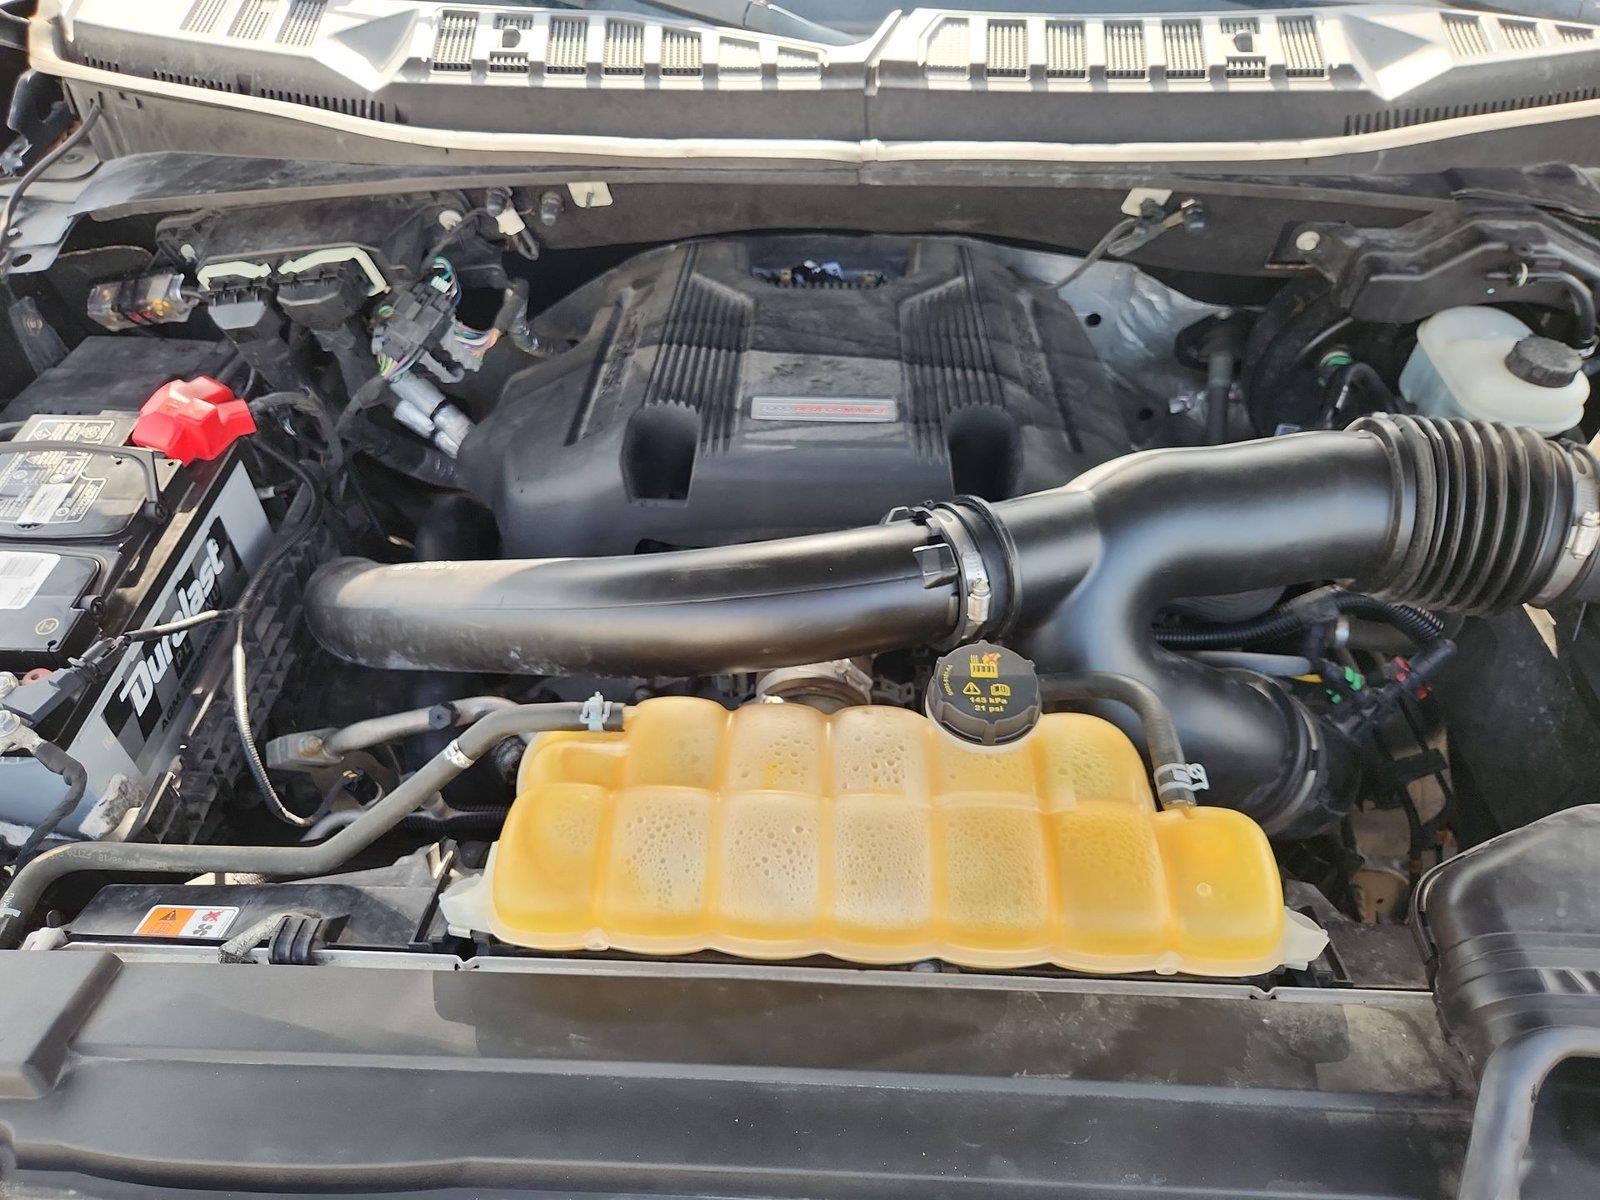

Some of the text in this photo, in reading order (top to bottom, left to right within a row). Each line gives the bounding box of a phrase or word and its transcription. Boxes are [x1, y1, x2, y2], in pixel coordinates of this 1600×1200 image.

[988, 696, 1008, 705] kPa
[161, 692, 182, 732] AGM
[974, 704, 1004, 713] 21 psi
